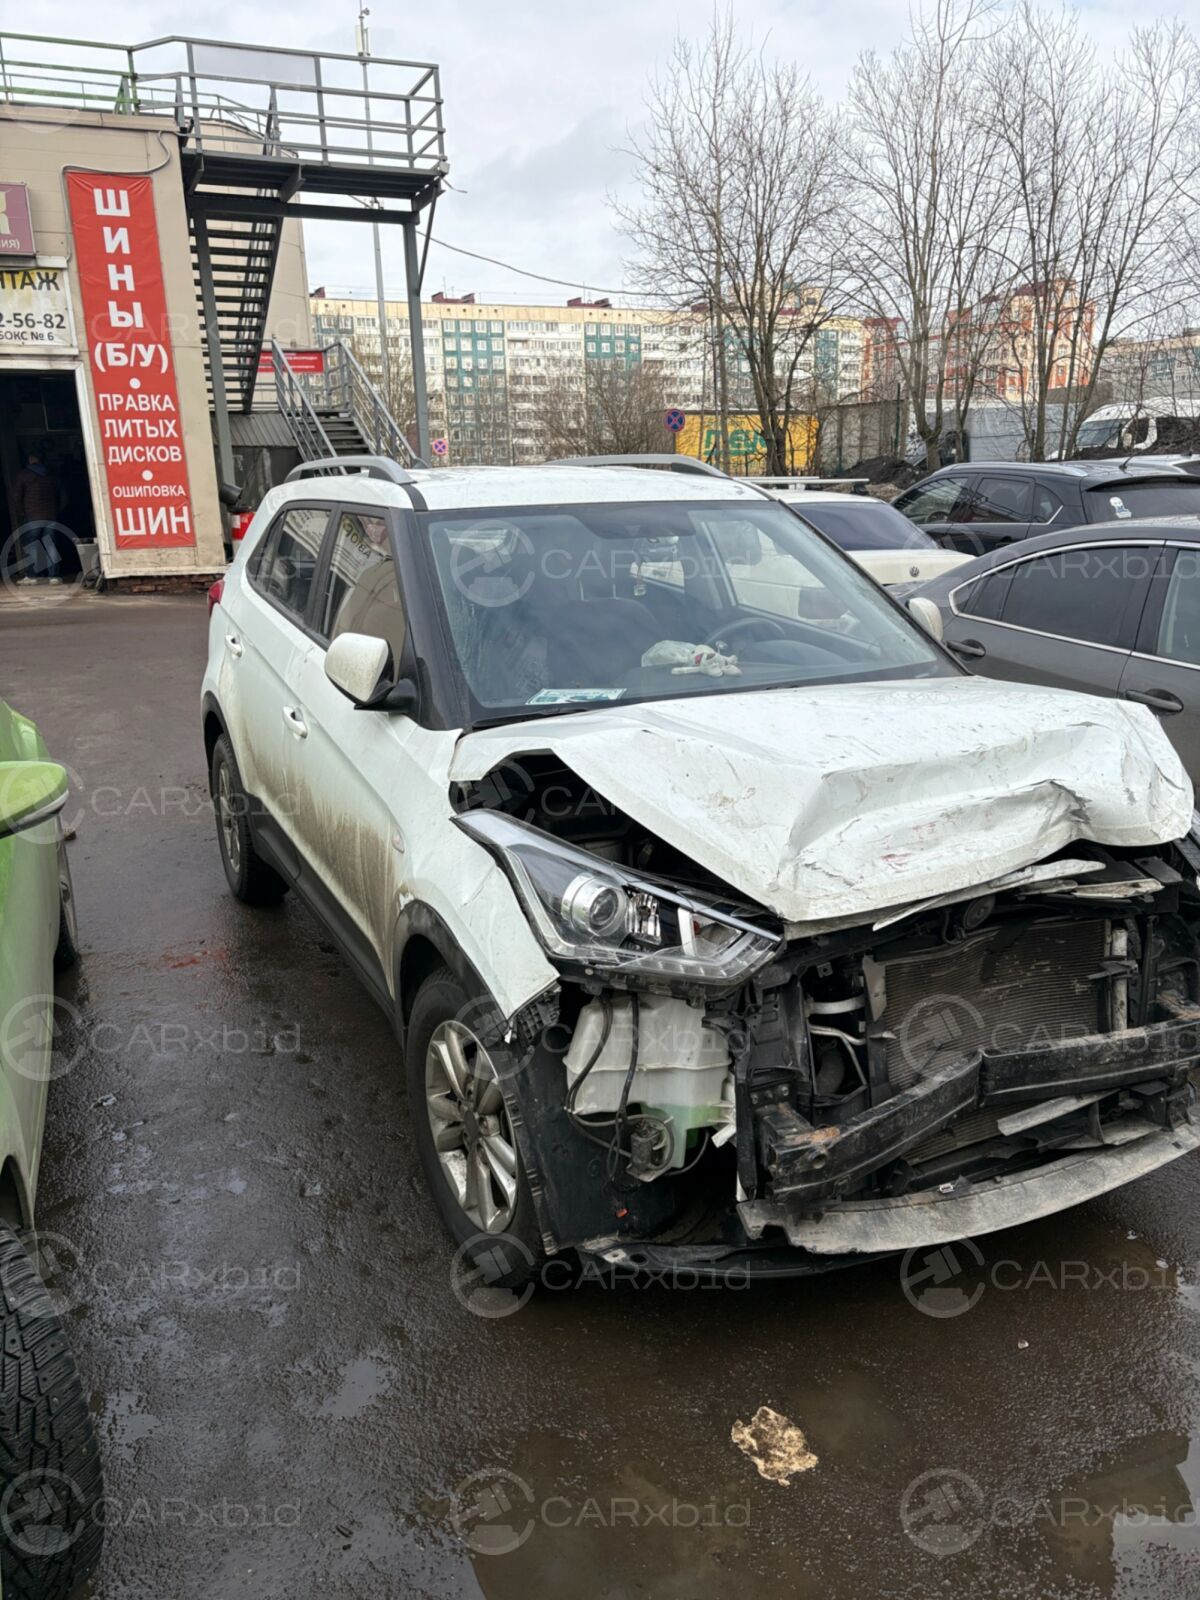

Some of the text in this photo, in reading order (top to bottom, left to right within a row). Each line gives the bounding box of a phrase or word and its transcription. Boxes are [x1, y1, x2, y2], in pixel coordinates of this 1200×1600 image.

[0, 238, 20, 250] ИЯ)
[93, 187, 145, 329] ШИНЫ
[47, 332, 54, 341] 6
[94, 342, 169, 374] (Б/У)
[98, 393, 176, 412] ПРАВКА
[104, 418, 179, 438] ЛИТЫХ
[108, 445, 182, 466] ДИСКОВ
[112, 484, 186, 498] ОШИПОВКА
[114, 505, 191, 536] ШИН
